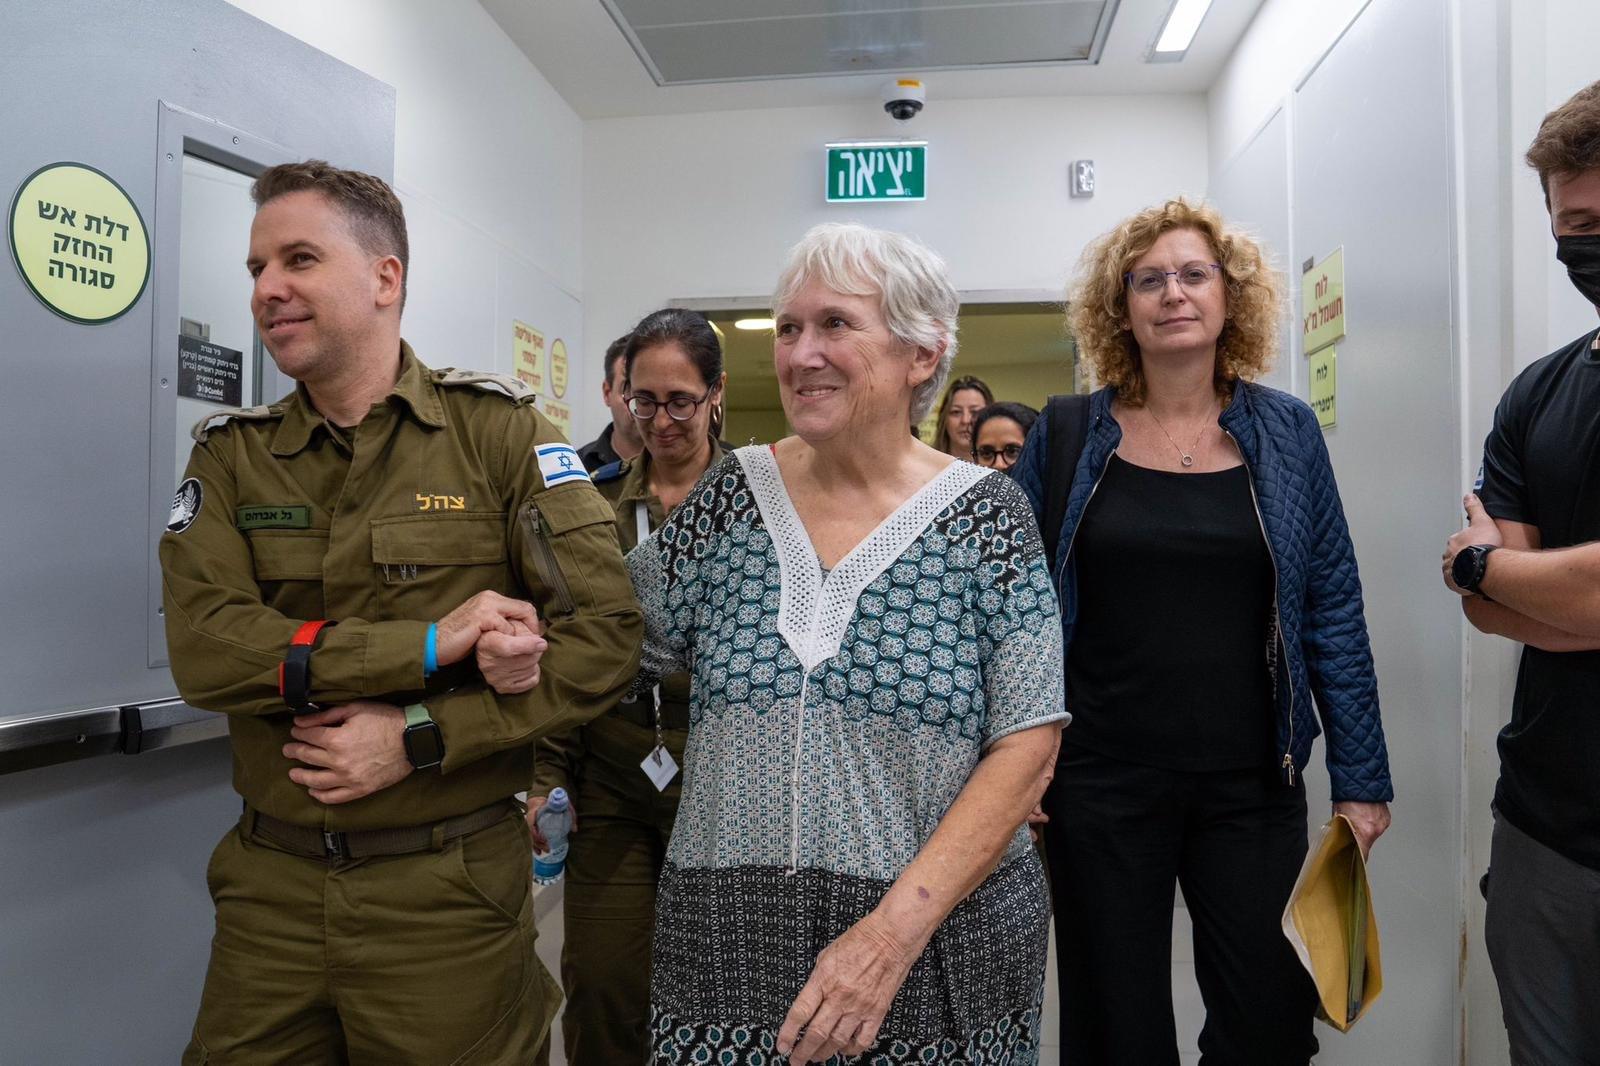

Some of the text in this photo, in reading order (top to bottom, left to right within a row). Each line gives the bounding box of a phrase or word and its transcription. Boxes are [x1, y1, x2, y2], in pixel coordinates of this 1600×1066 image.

[838, 151, 912, 196] יציאה
[38, 200, 129, 242] דלת אש
[53, 232, 113, 264] החזק
[48, 258, 115, 290] סגורה
[1315, 273, 1328, 300] לוח
[1318, 296, 1342, 327] חשמל
[1316, 361, 1328, 383] לוח
[245, 511, 278, 521] אברהם
